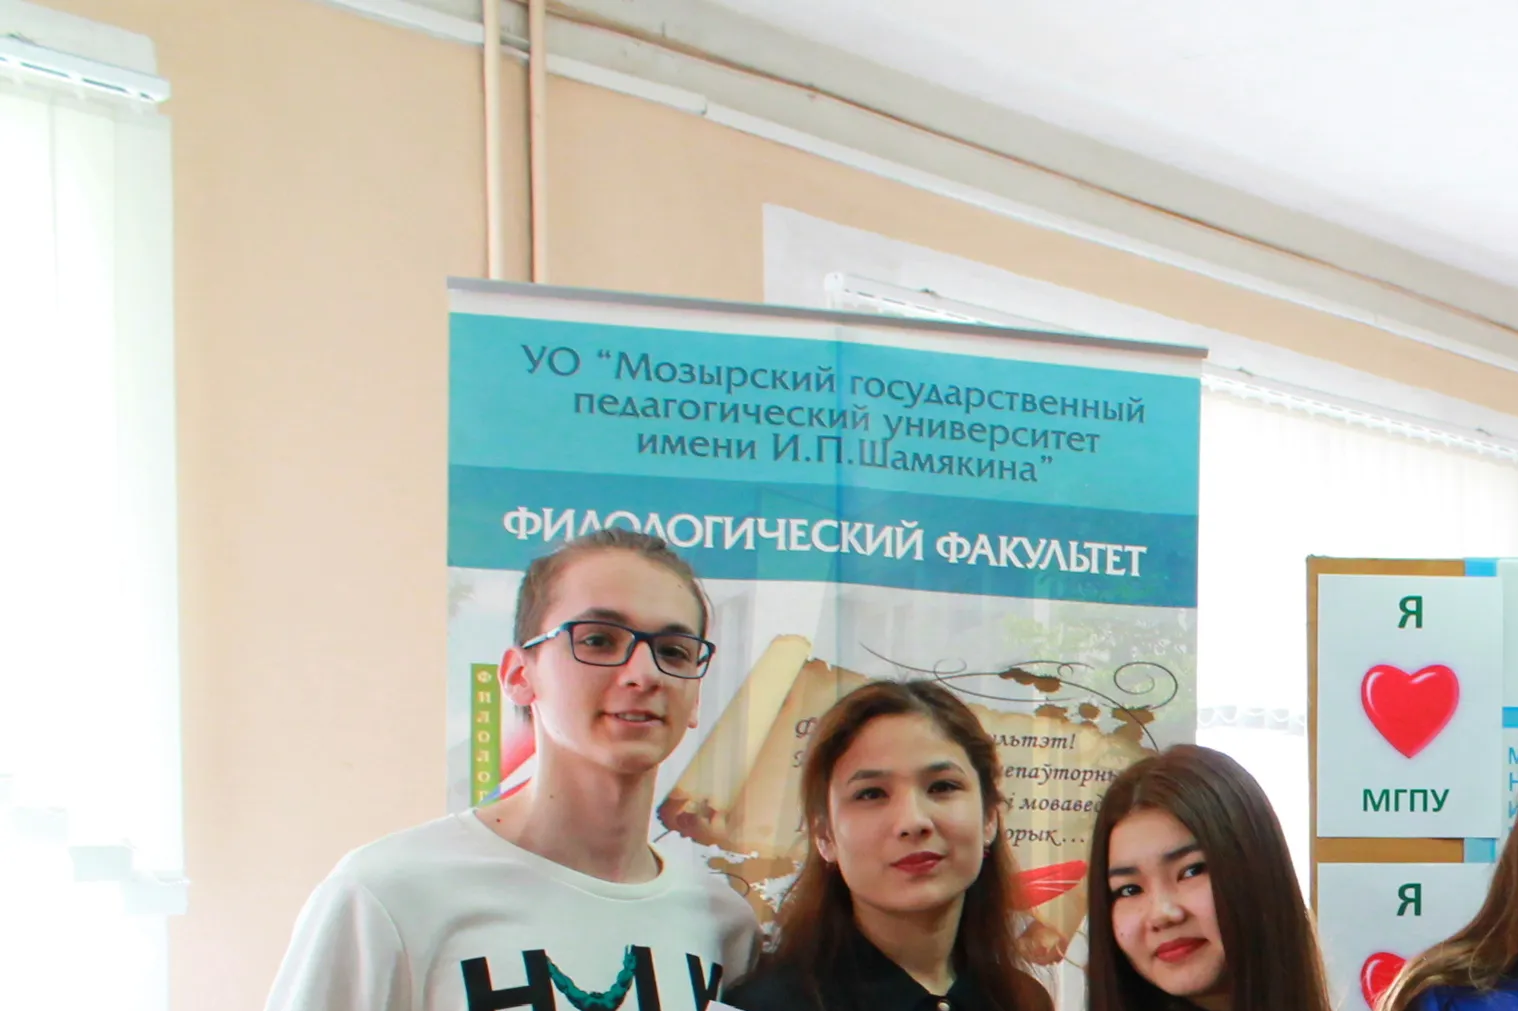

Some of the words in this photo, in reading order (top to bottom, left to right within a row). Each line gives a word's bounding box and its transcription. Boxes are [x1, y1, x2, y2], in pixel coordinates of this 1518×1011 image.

[521, 344, 581, 377] УО
[849, 374, 1146, 424] государственный
[573, 392, 870, 432] педагогический
[883, 413, 1101, 453] университет
[637, 432, 757, 461] имени
[935, 531, 1148, 578] ФАКУЛЬТЕТ
[1397, 595, 1424, 629] Я
[1362, 788, 1450, 813] МГПУ
[1396, 883, 1423, 917] Я
